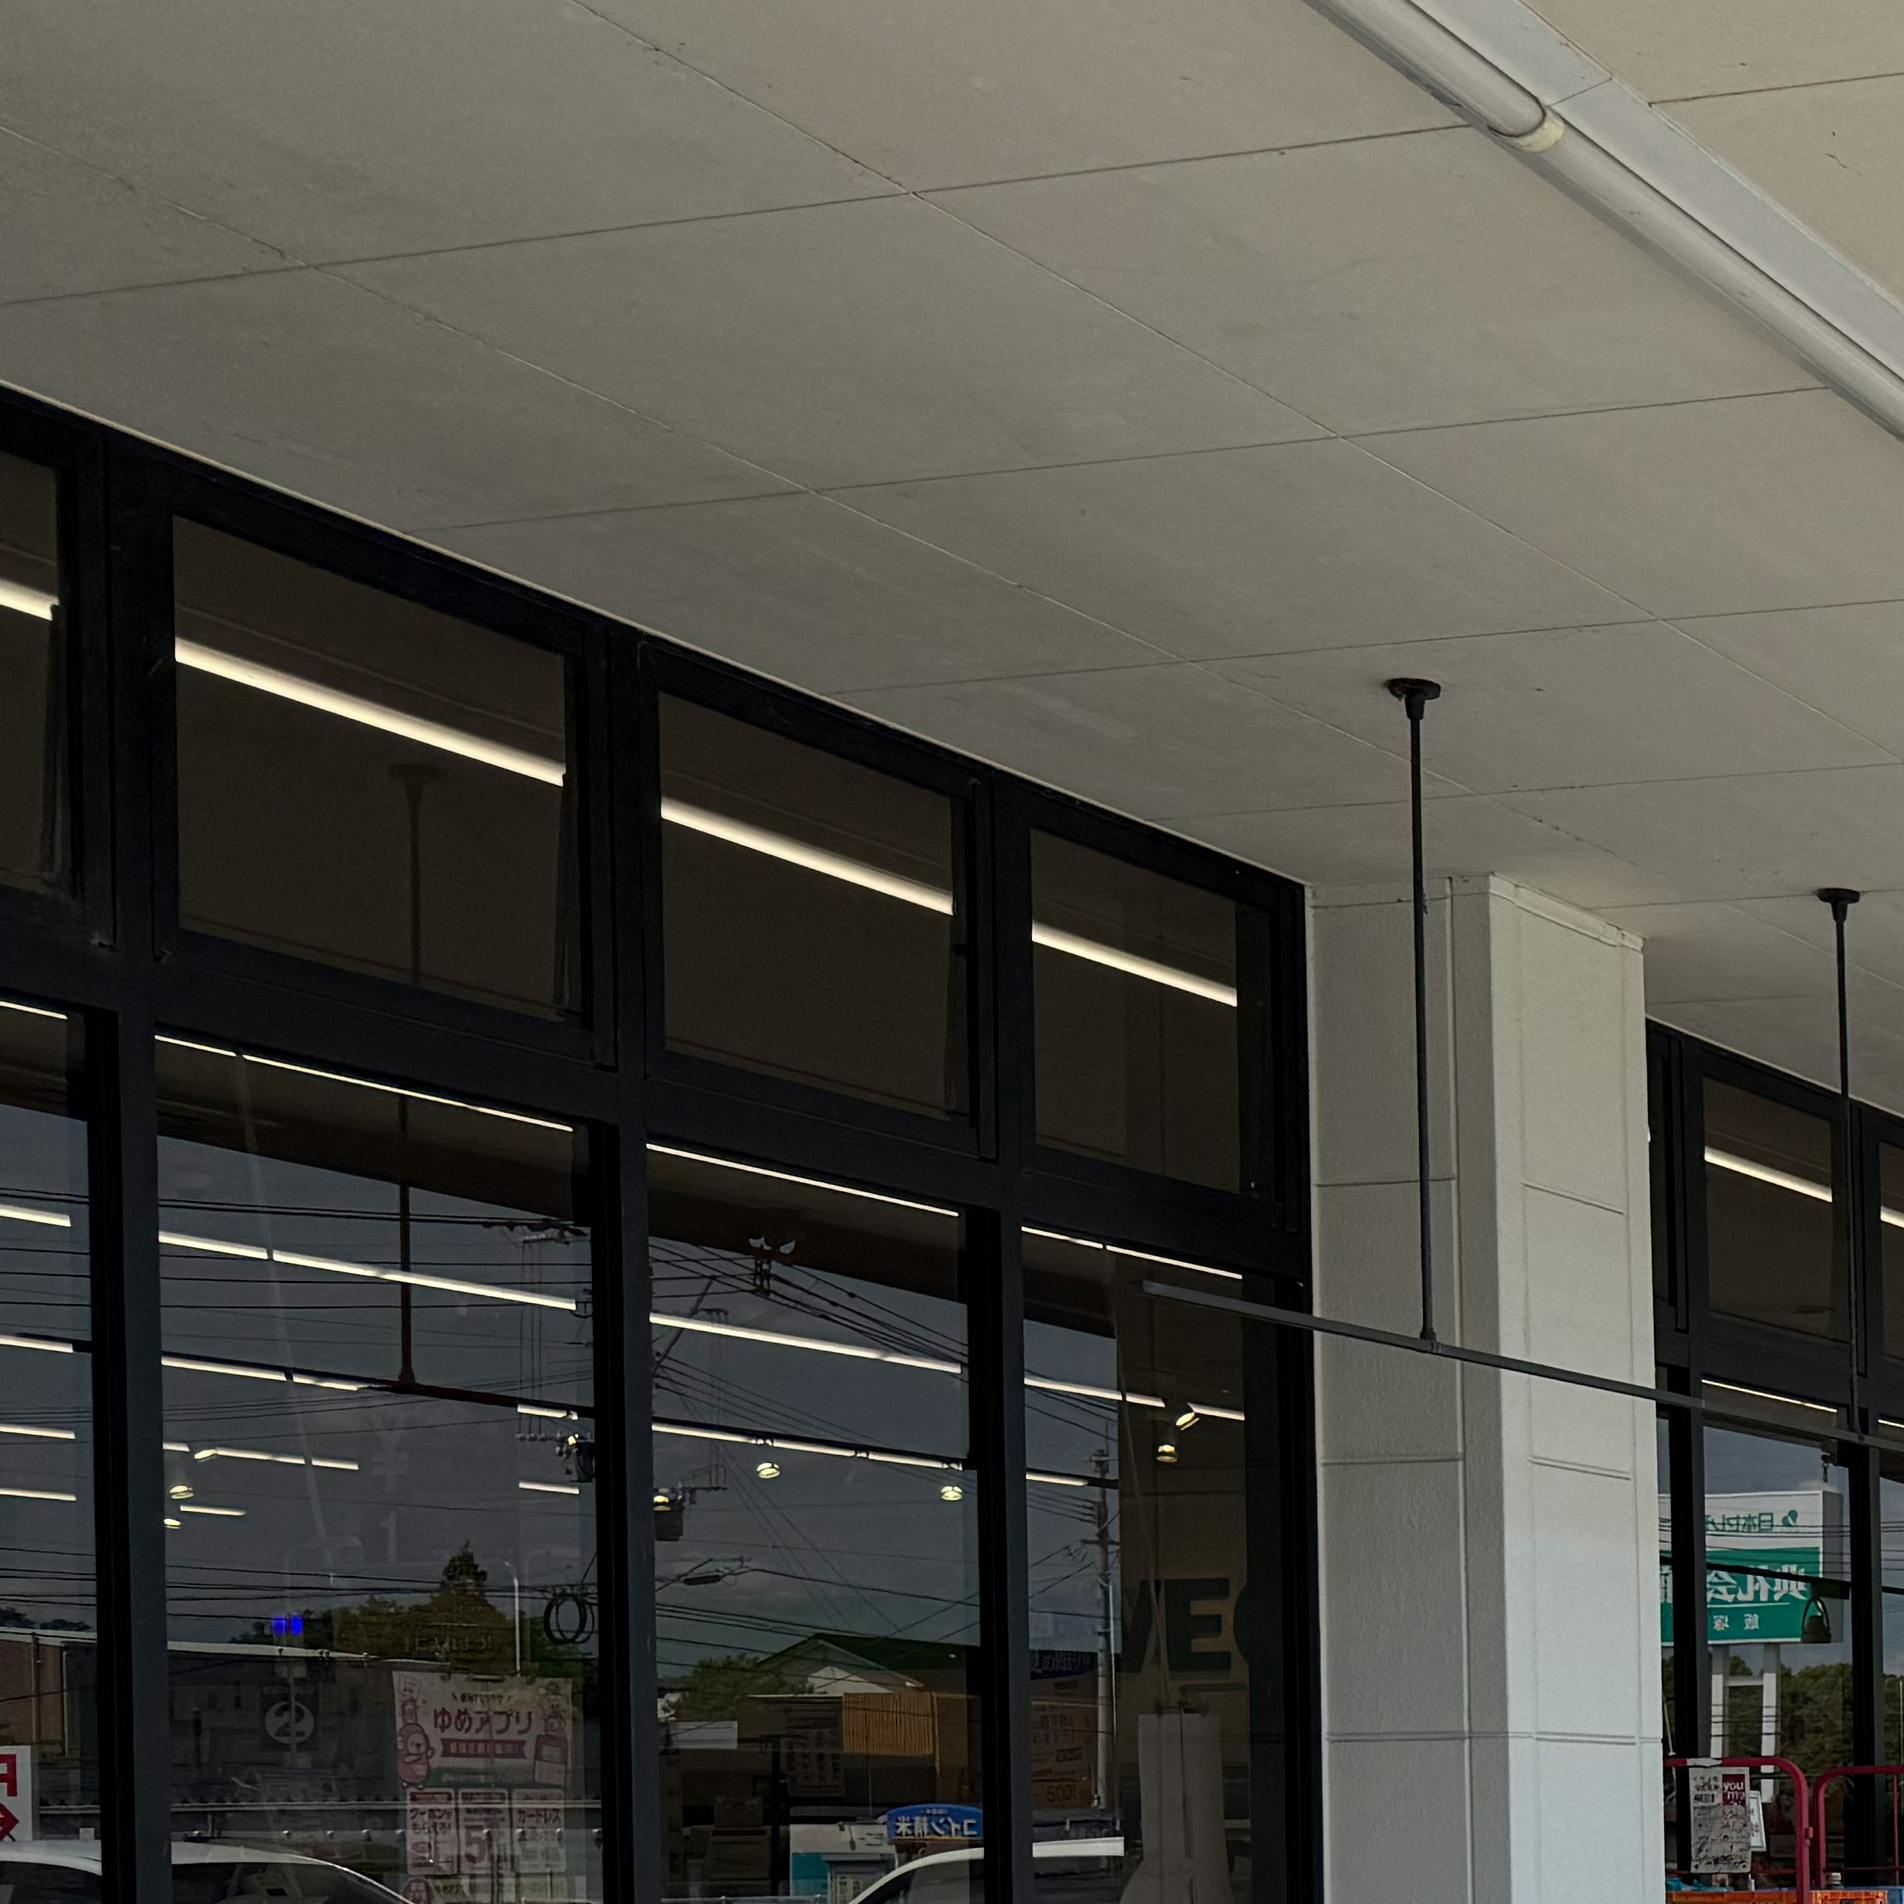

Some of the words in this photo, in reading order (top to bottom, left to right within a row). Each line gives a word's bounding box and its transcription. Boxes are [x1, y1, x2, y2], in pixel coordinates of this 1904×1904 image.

[433, 1707, 533, 1735] ゆめアプリ
[1723, 1781, 1744, 1793] you
